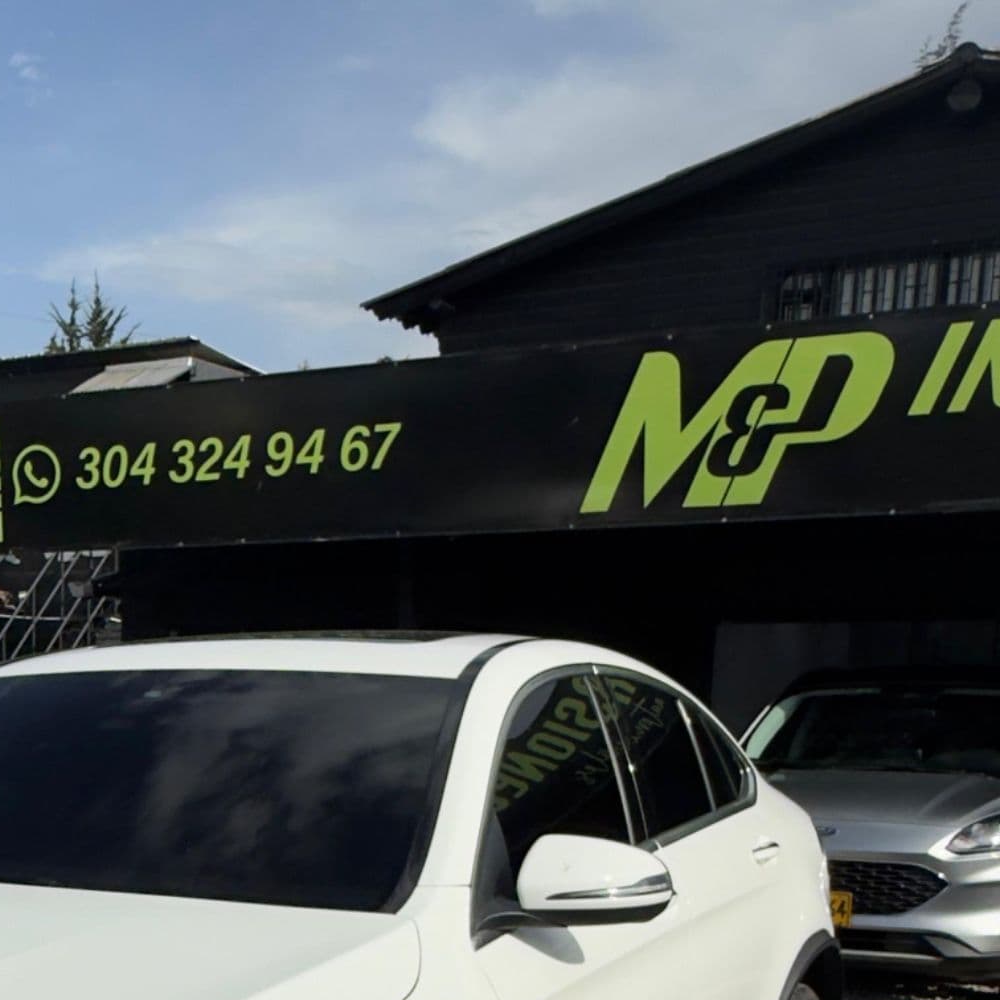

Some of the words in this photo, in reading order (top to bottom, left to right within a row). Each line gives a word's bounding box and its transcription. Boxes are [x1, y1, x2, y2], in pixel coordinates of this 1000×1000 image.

[75, 442, 156, 490] 304
[168, 434, 251, 484] 324
[264, 428, 326, 478] 94
[339, 422, 402, 472] 67
[580, 331, 896, 513] M&P
